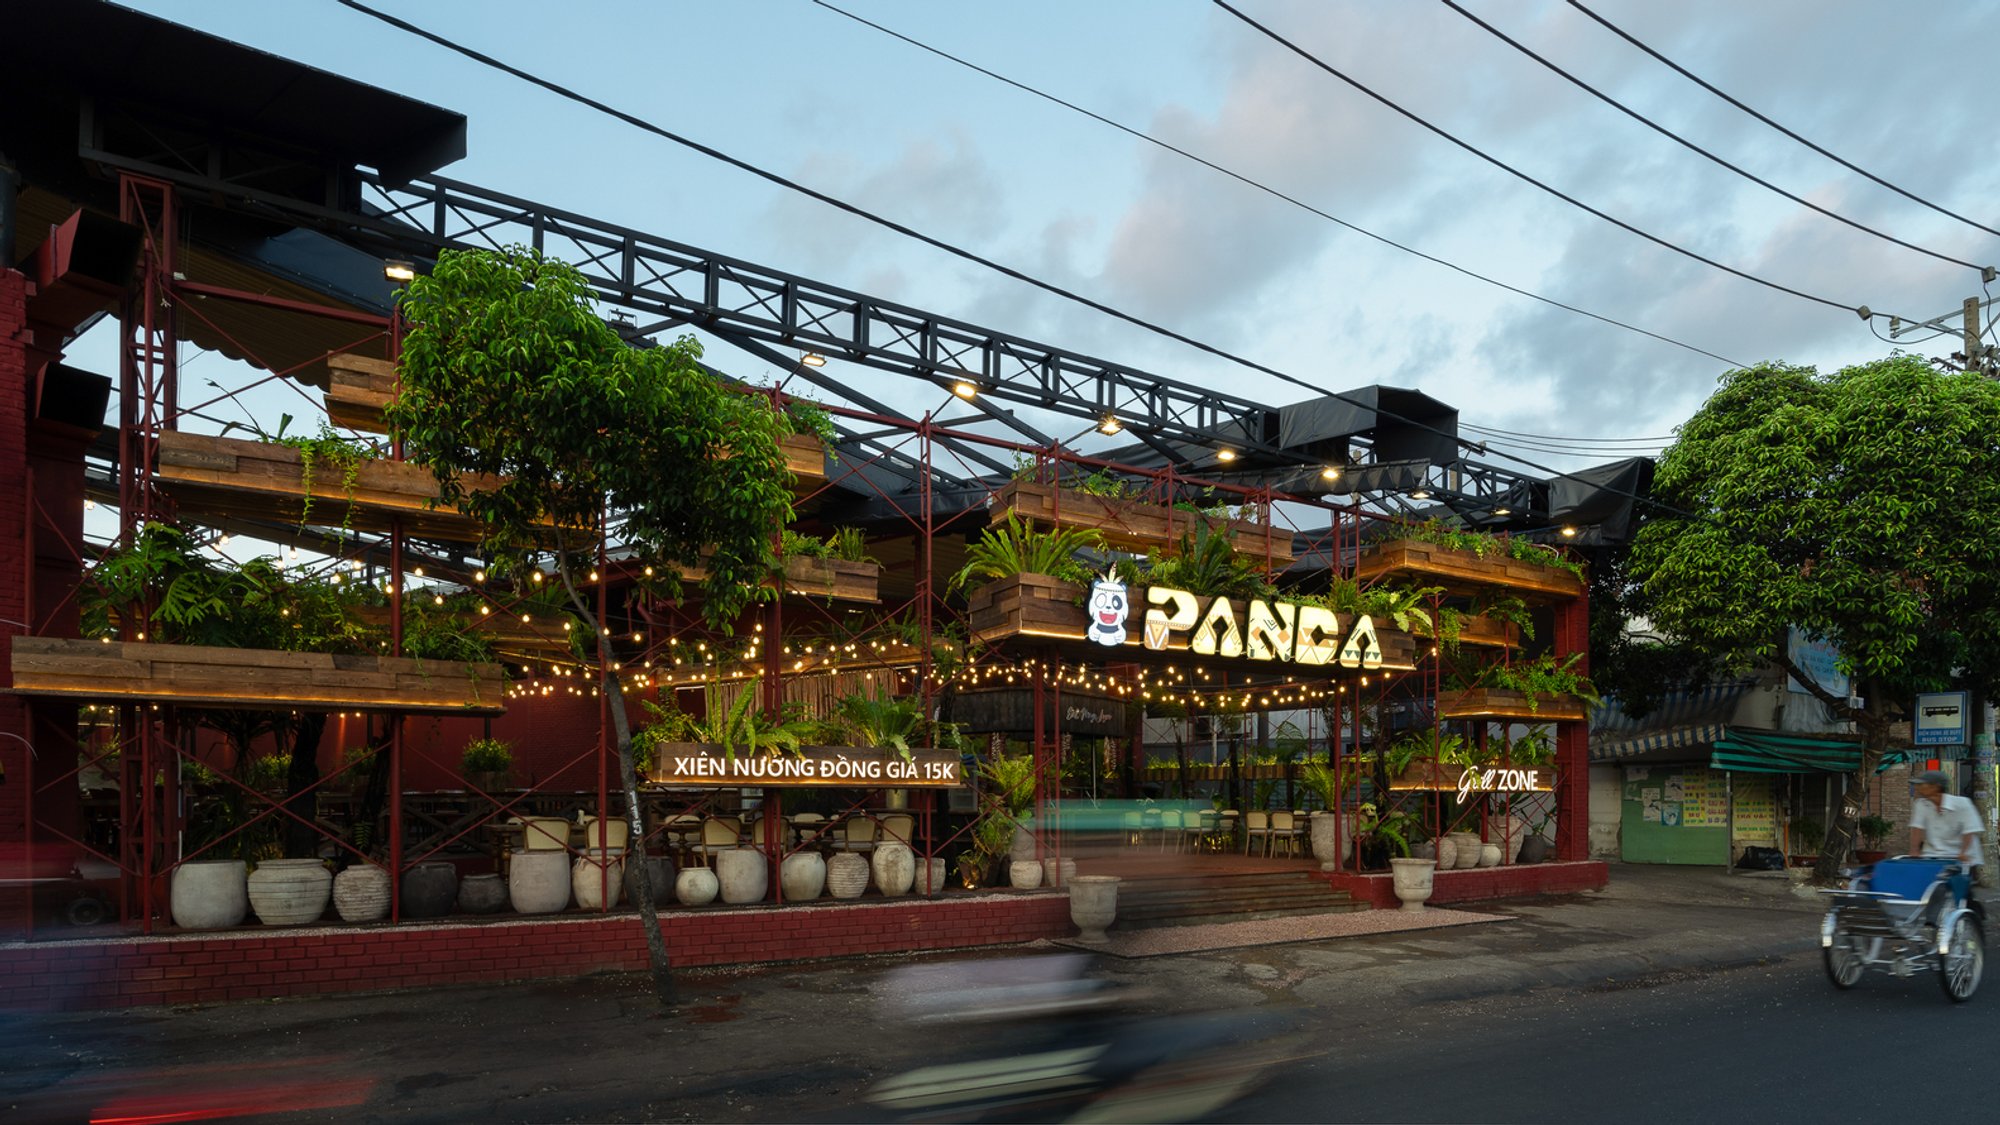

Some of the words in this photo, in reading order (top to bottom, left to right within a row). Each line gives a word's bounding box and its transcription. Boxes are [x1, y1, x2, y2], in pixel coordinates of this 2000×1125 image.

[1144, 586, 1383, 669] PANCA
[674, 751, 726, 777] XIÊN
[820, 754, 881, 779] ĐỒNG
[886, 756, 919, 779] GIÁ
[923, 762, 955, 780] 15K
[1497, 769, 1539, 792] ZONE
